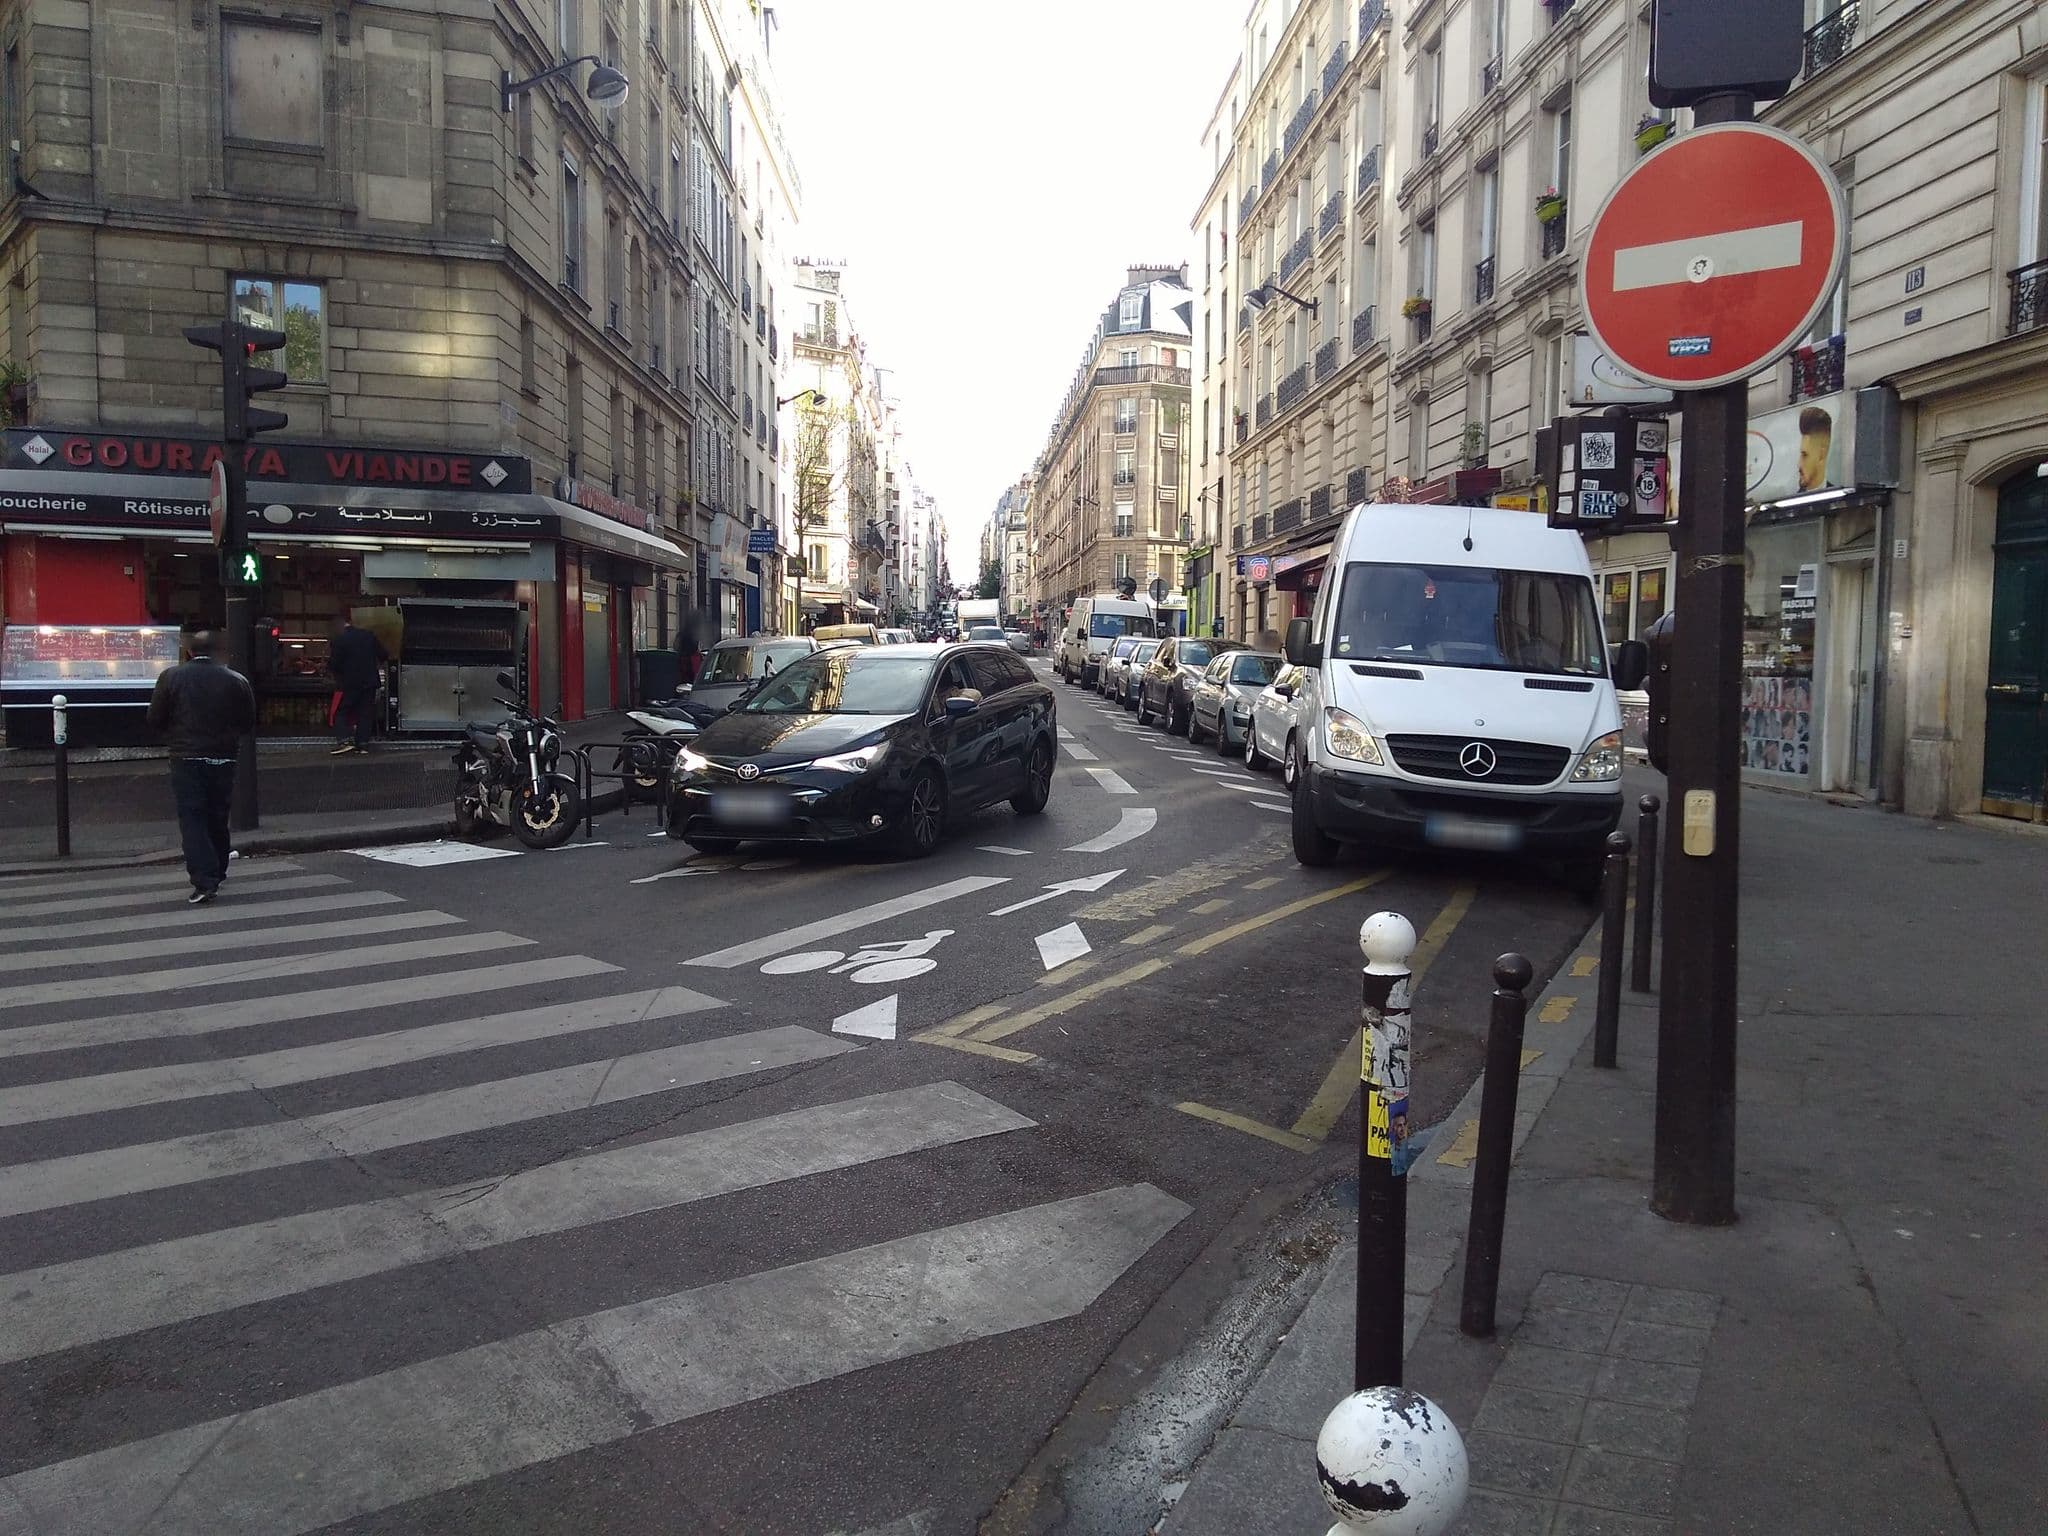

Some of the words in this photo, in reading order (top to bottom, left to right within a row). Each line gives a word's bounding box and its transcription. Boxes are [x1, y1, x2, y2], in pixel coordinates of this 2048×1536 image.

[1907, 269, 1922, 291] 113
[28, 444, 49, 454] Halal
[325, 452, 472, 485] VIANDE
[1643, 480, 1654, 491] 18
[0, 496, 87, 511] oucherie
[1584, 493, 1616, 505] SILK
[1584, 504, 1617, 516] RALE
